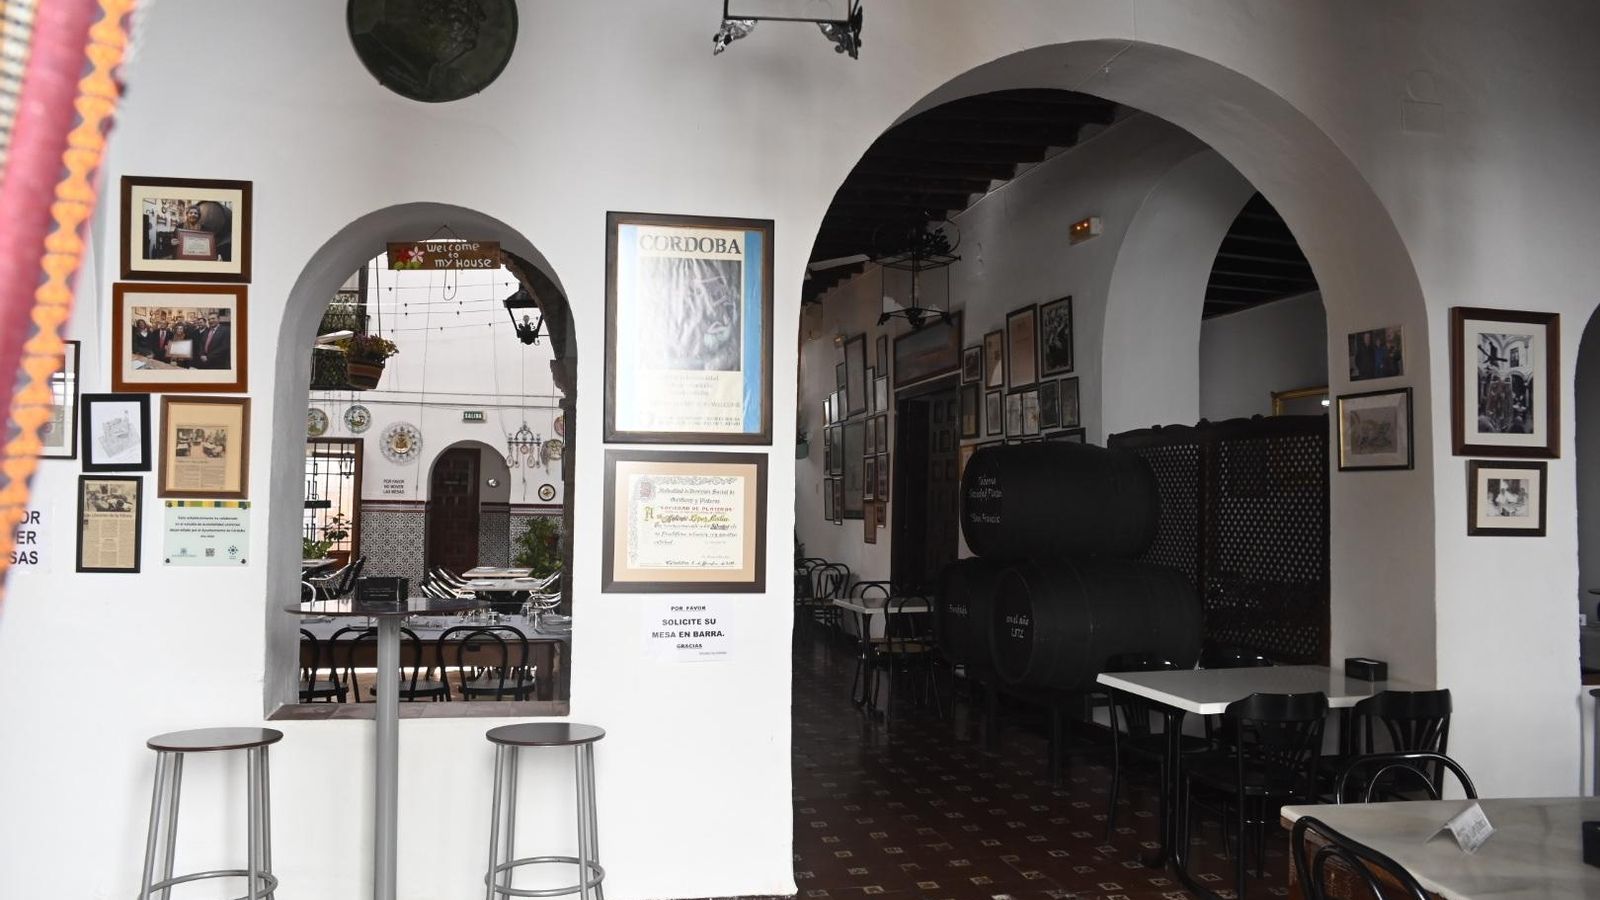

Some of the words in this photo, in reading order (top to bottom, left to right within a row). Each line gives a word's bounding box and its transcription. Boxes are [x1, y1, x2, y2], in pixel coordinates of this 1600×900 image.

[639, 233, 742, 255] CORDOBA
[19, 510, 41, 525] OR
[16, 530, 37, 545] ER
[8, 550, 39, 565] SAS
[661, 618, 702, 626] SOLICITE
[704, 617, 717, 626] SU
[651, 631, 677, 639] MESA
[692, 630, 725, 638] BARRA.
